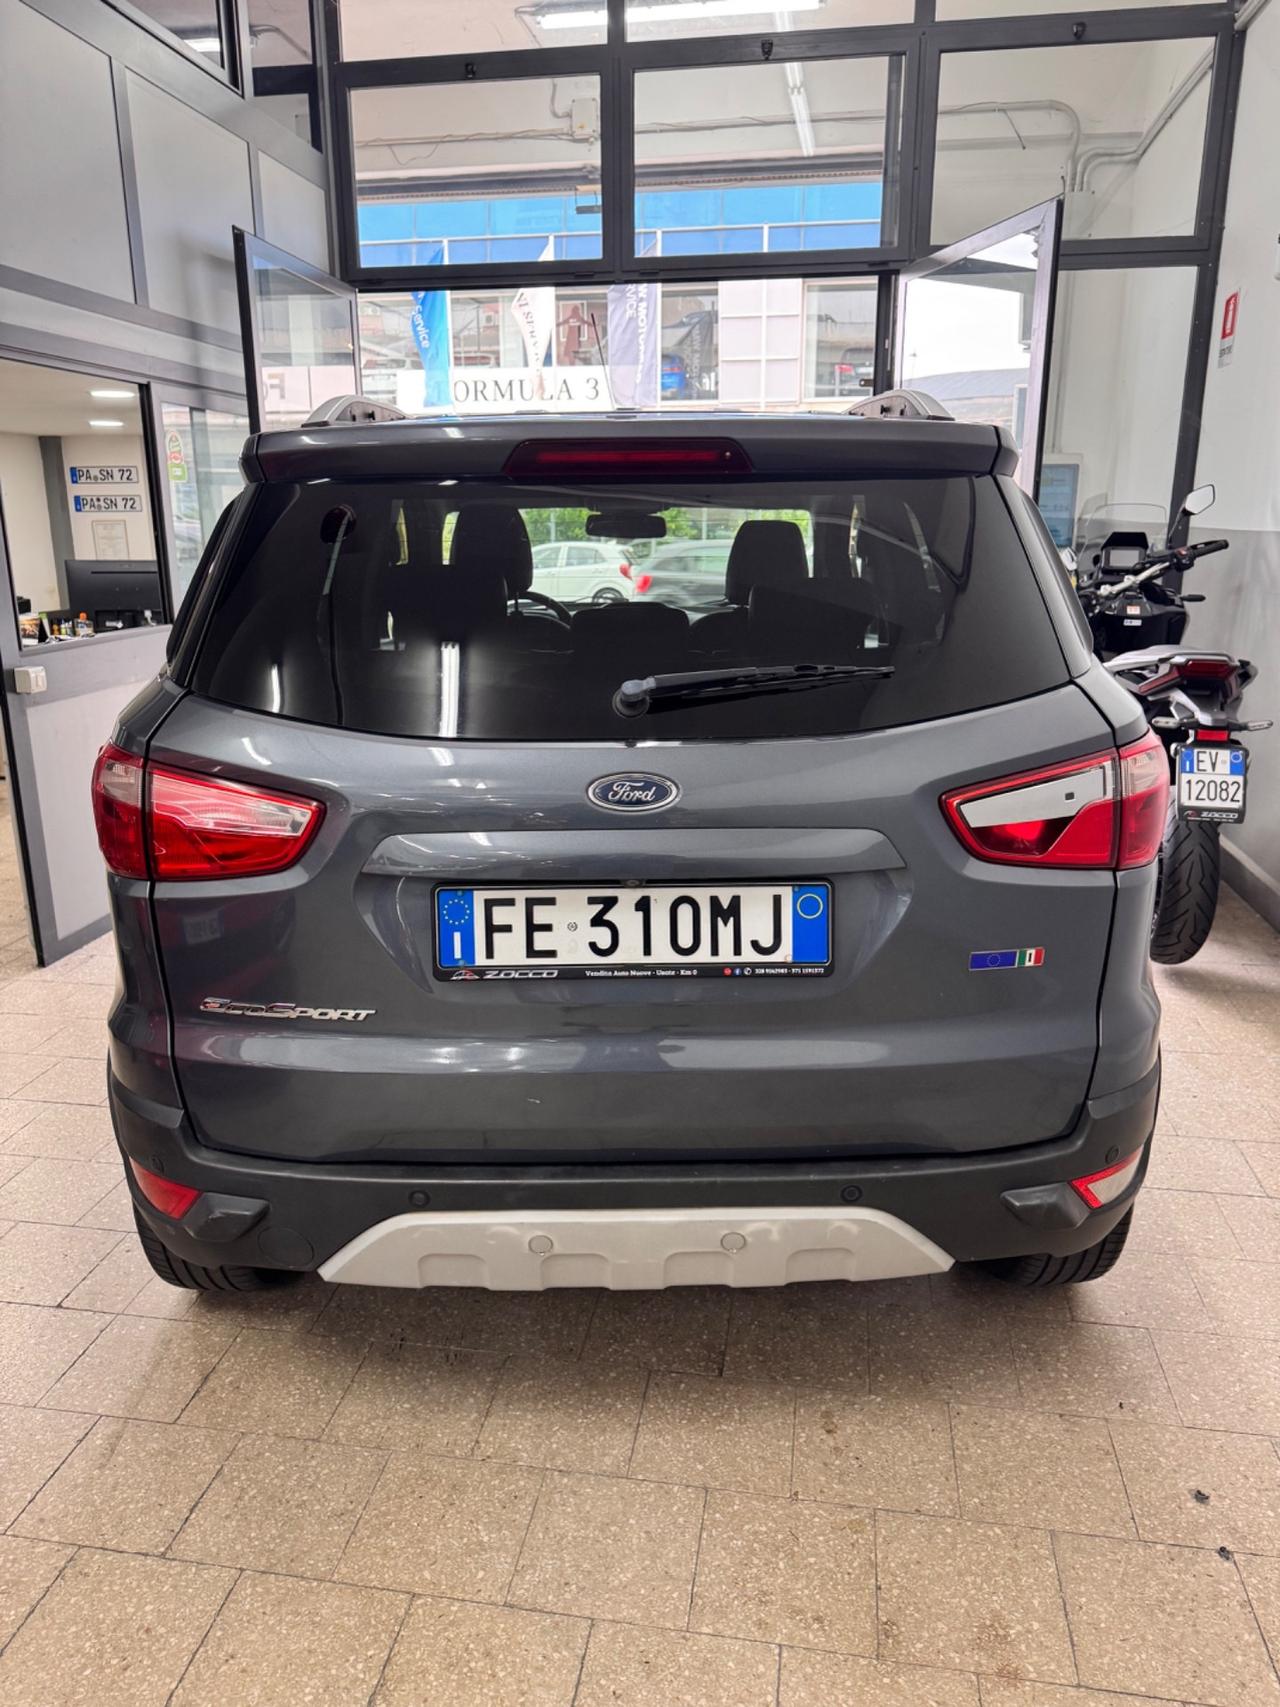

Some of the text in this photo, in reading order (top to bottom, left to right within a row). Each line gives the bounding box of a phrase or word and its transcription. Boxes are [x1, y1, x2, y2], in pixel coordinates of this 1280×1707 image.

[586, 377, 600, 401] 3
[77, 469, 133, 481] PA SN 72
[82, 498, 137, 510] PA SN 72
[1197, 751, 1219, 772] EV
[608, 781, 657, 802] Ford
[1186, 779, 1241, 803] 12082
[484, 896, 558, 960] FE
[586, 893, 783, 957] 310MJ
[483, 969, 559, 979] ZOCCO
